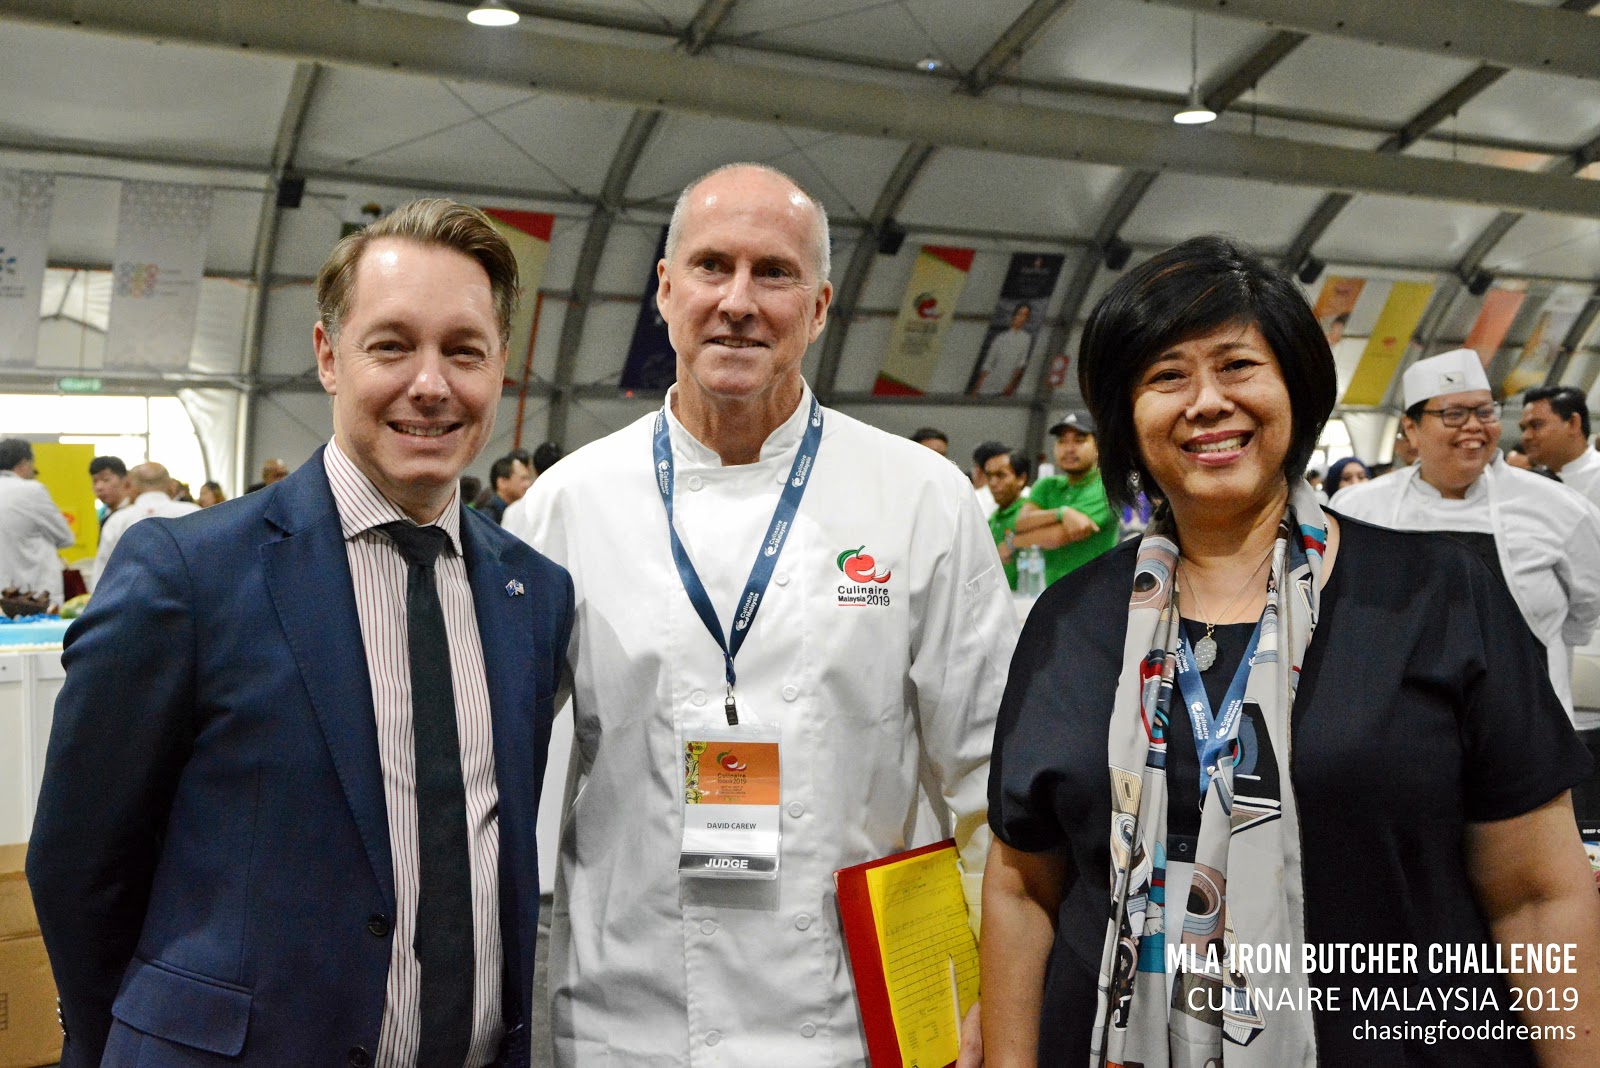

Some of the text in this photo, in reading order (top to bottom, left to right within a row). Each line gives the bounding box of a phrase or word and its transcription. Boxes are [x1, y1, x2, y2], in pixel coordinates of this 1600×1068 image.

[796, 454, 807, 477] Culinaire
[768, 520, 783, 545] Culinaire
[774, 523, 788, 545] Malaysia
[837, 585, 890, 596] Culinaire
[837, 594, 891, 607] Malaysia 2019
[740, 591, 754, 618] Culinaire
[745, 593, 760, 620] Malaysia
[1221, 700, 1235, 727] Culinaire
[1228, 699, 1242, 723] Malaysia
[1194, 714, 1204, 740] Malaysia
[1198, 712, 1209, 740] Culinaire
[706, 822, 757, 830] DAVID CAREW
[704, 858, 749, 869] JUDGE
